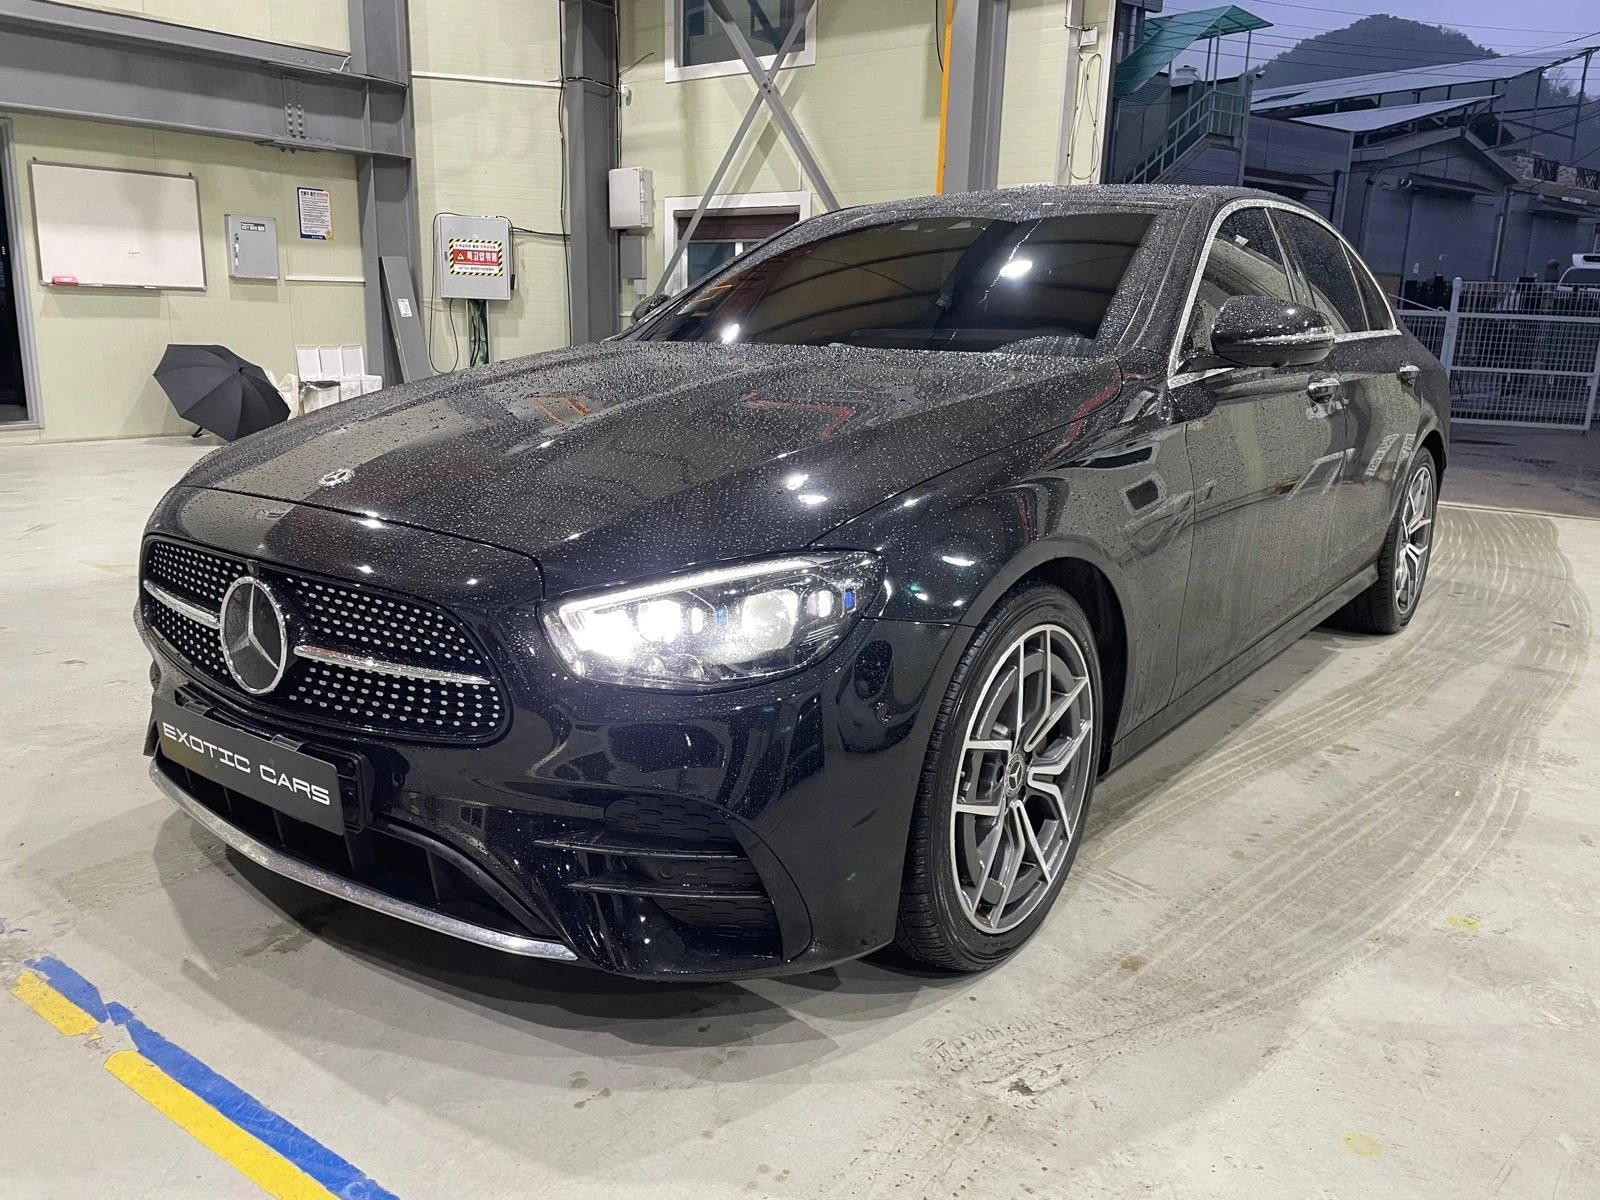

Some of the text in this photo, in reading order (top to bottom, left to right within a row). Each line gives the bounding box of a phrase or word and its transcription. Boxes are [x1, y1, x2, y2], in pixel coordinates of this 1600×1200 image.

[466, 251, 498, 262] 특고압위험
[162, 722, 330, 806] EXOTIC CARS
